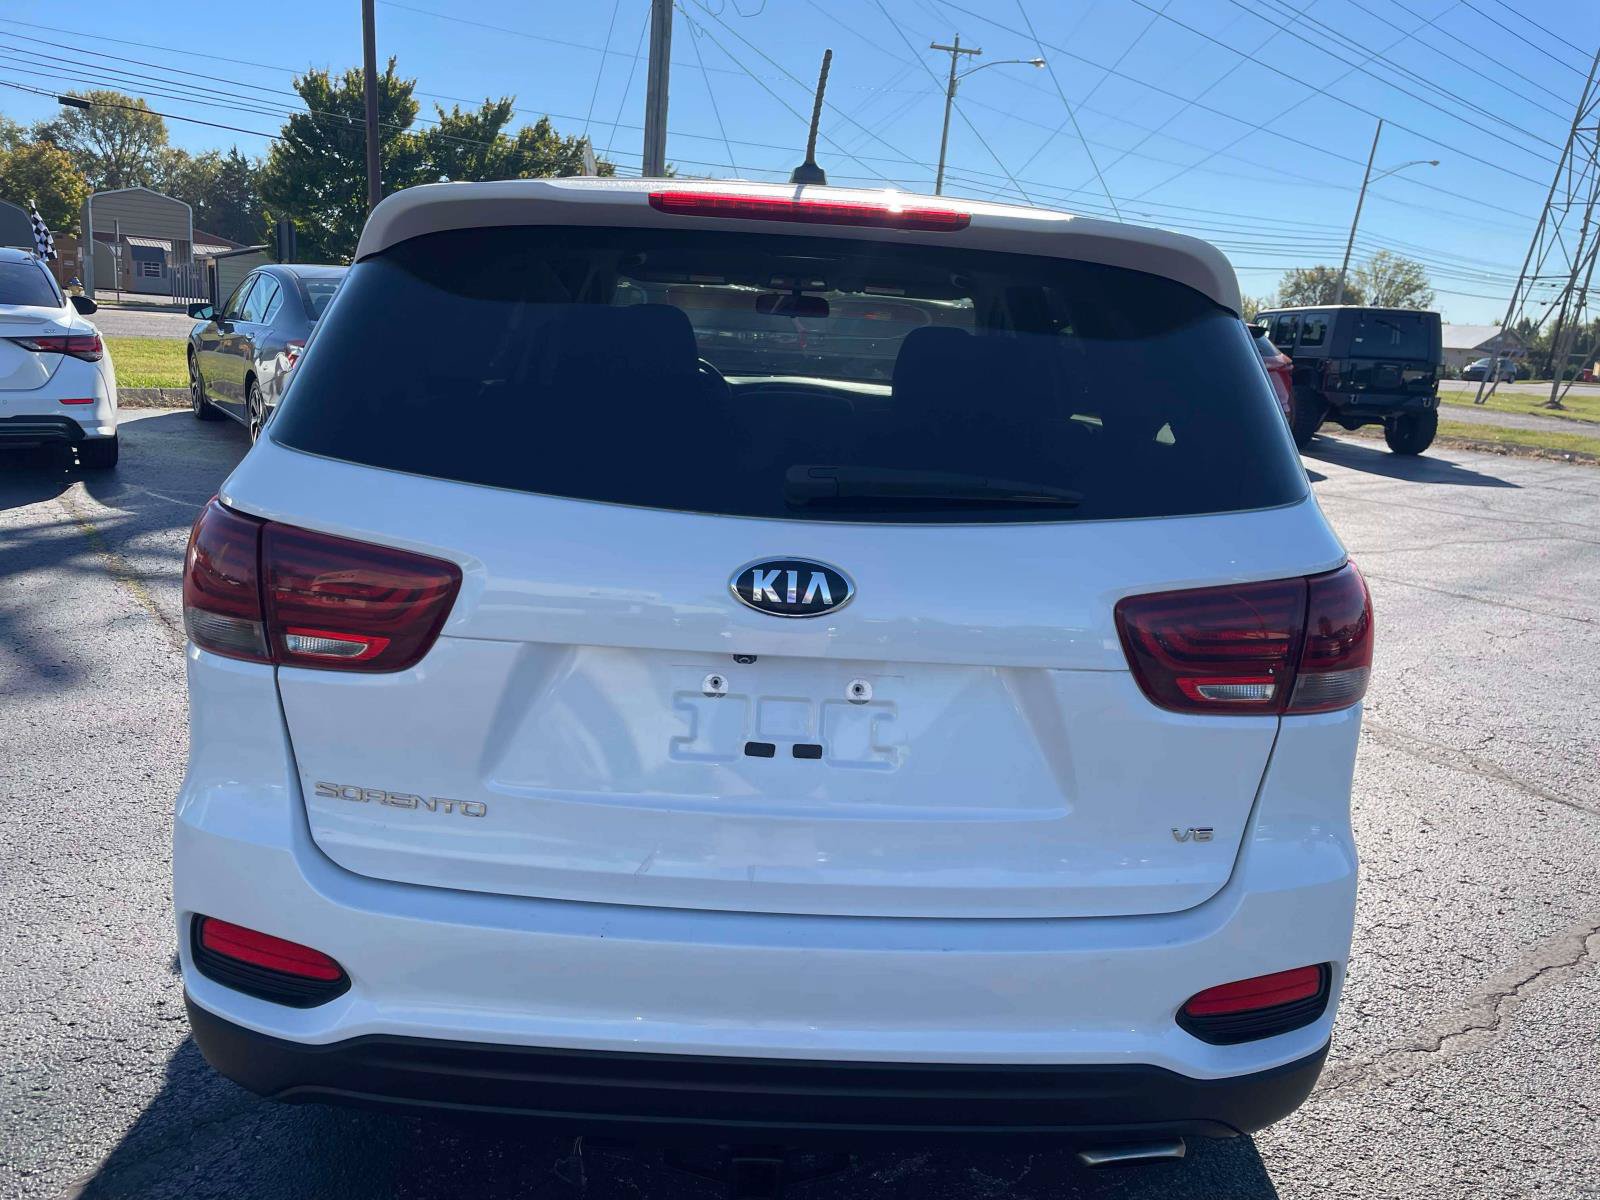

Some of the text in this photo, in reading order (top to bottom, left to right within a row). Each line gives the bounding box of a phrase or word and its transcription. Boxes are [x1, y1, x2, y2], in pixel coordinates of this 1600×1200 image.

[752, 569, 833, 605] KIA
[315, 781, 487, 818] SORENTO
[1171, 827, 1214, 843] V6
